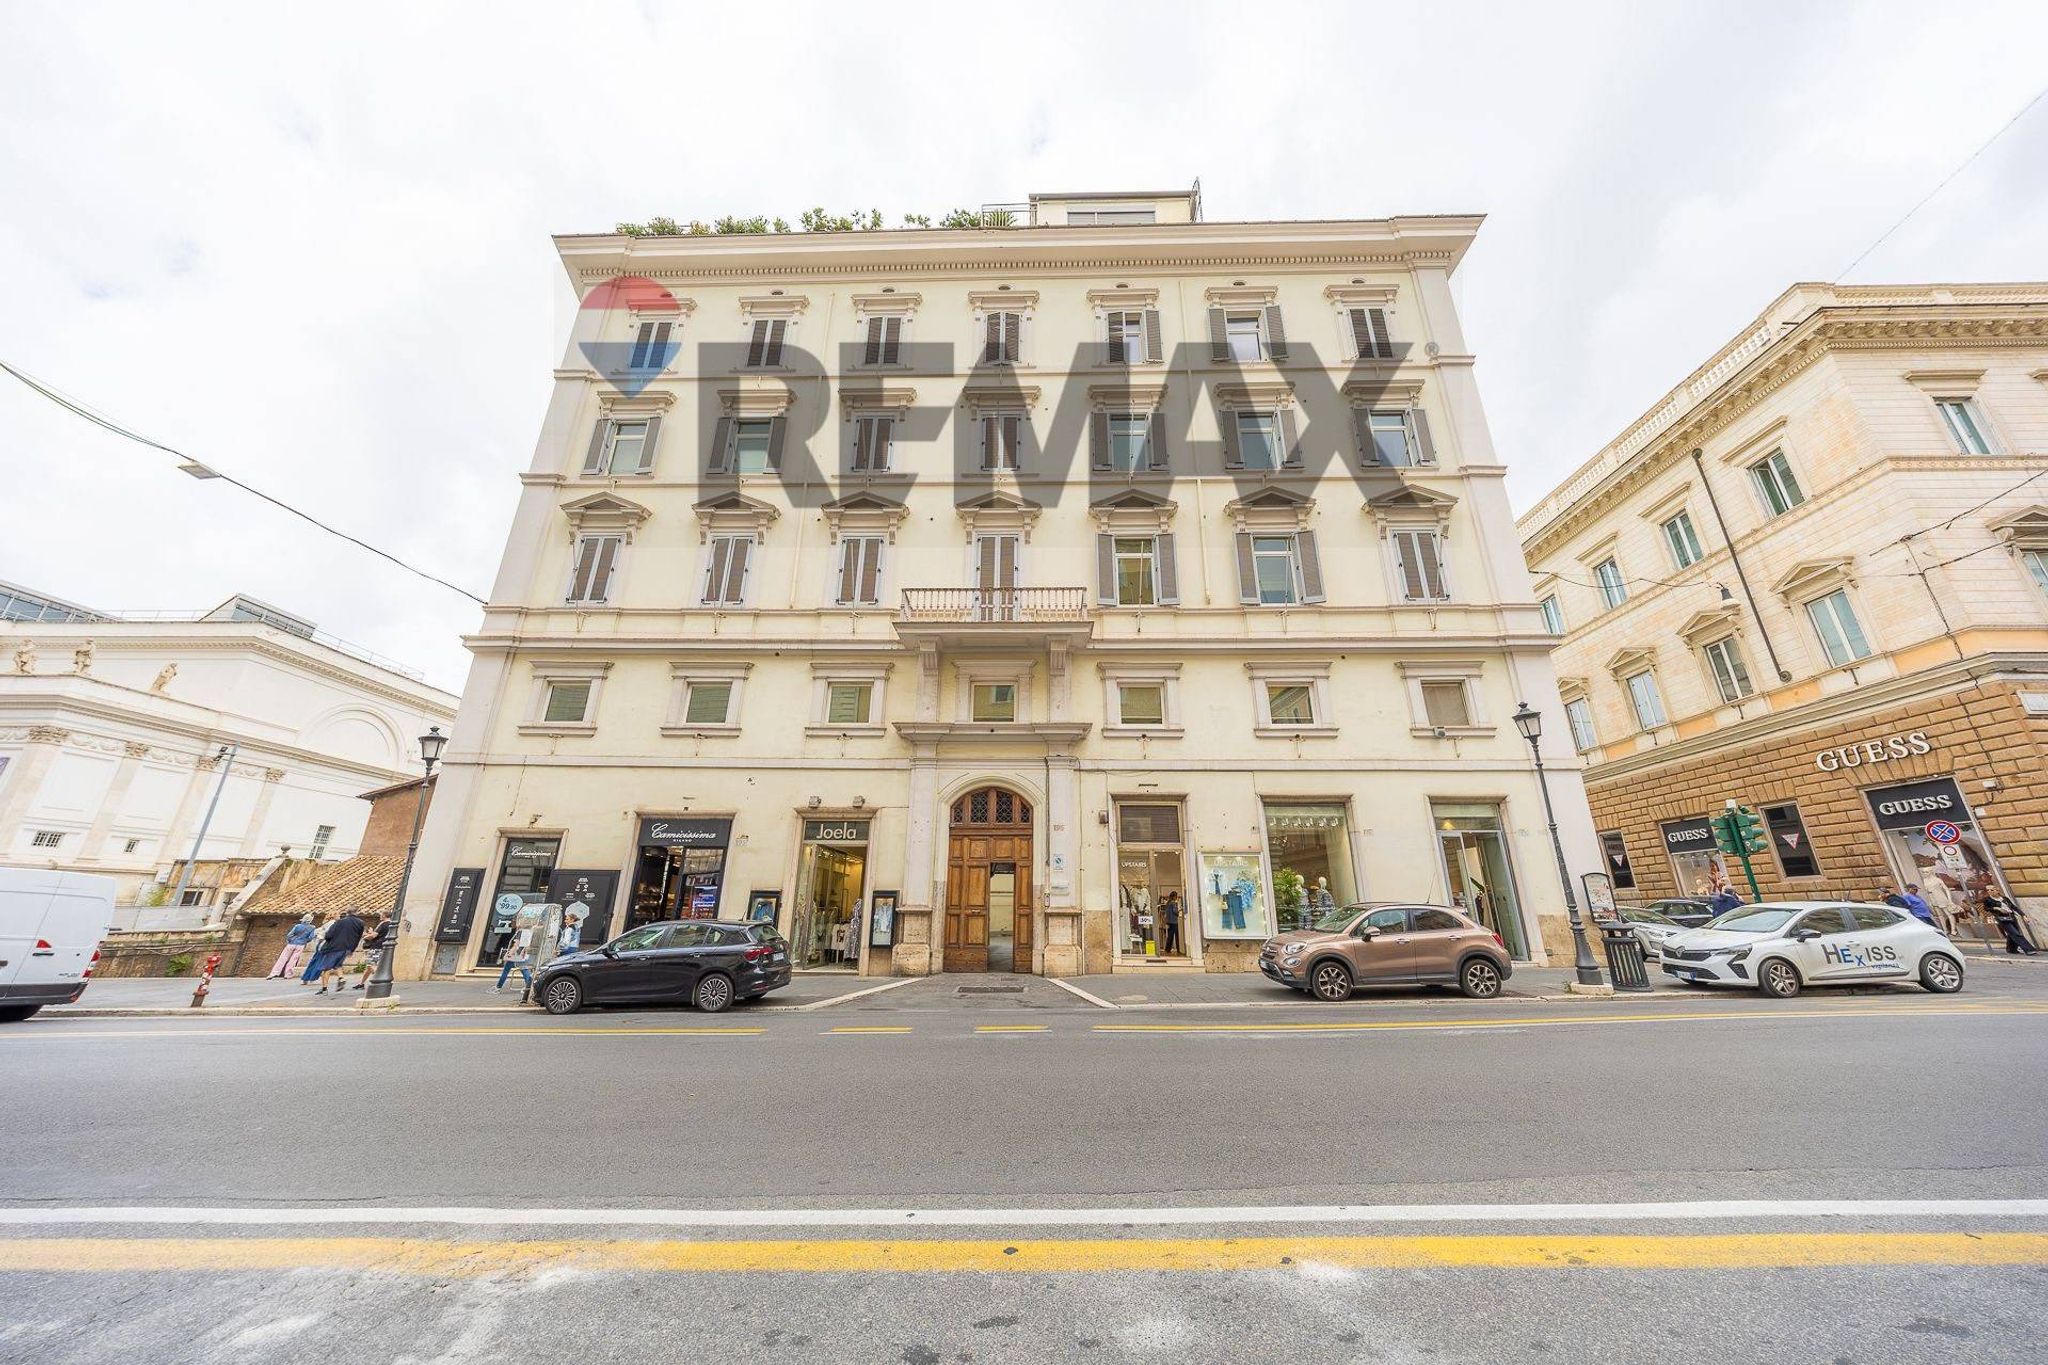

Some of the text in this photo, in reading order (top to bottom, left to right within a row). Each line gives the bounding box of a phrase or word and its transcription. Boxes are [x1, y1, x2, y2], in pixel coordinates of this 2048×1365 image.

[1816, 731, 1931, 772] GUESS
[1879, 794, 1952, 815] GUESS
[651, 823, 716, 839] Camicissima
[816, 822, 857, 840] Joela
[1668, 828, 1708, 843] GUESS
